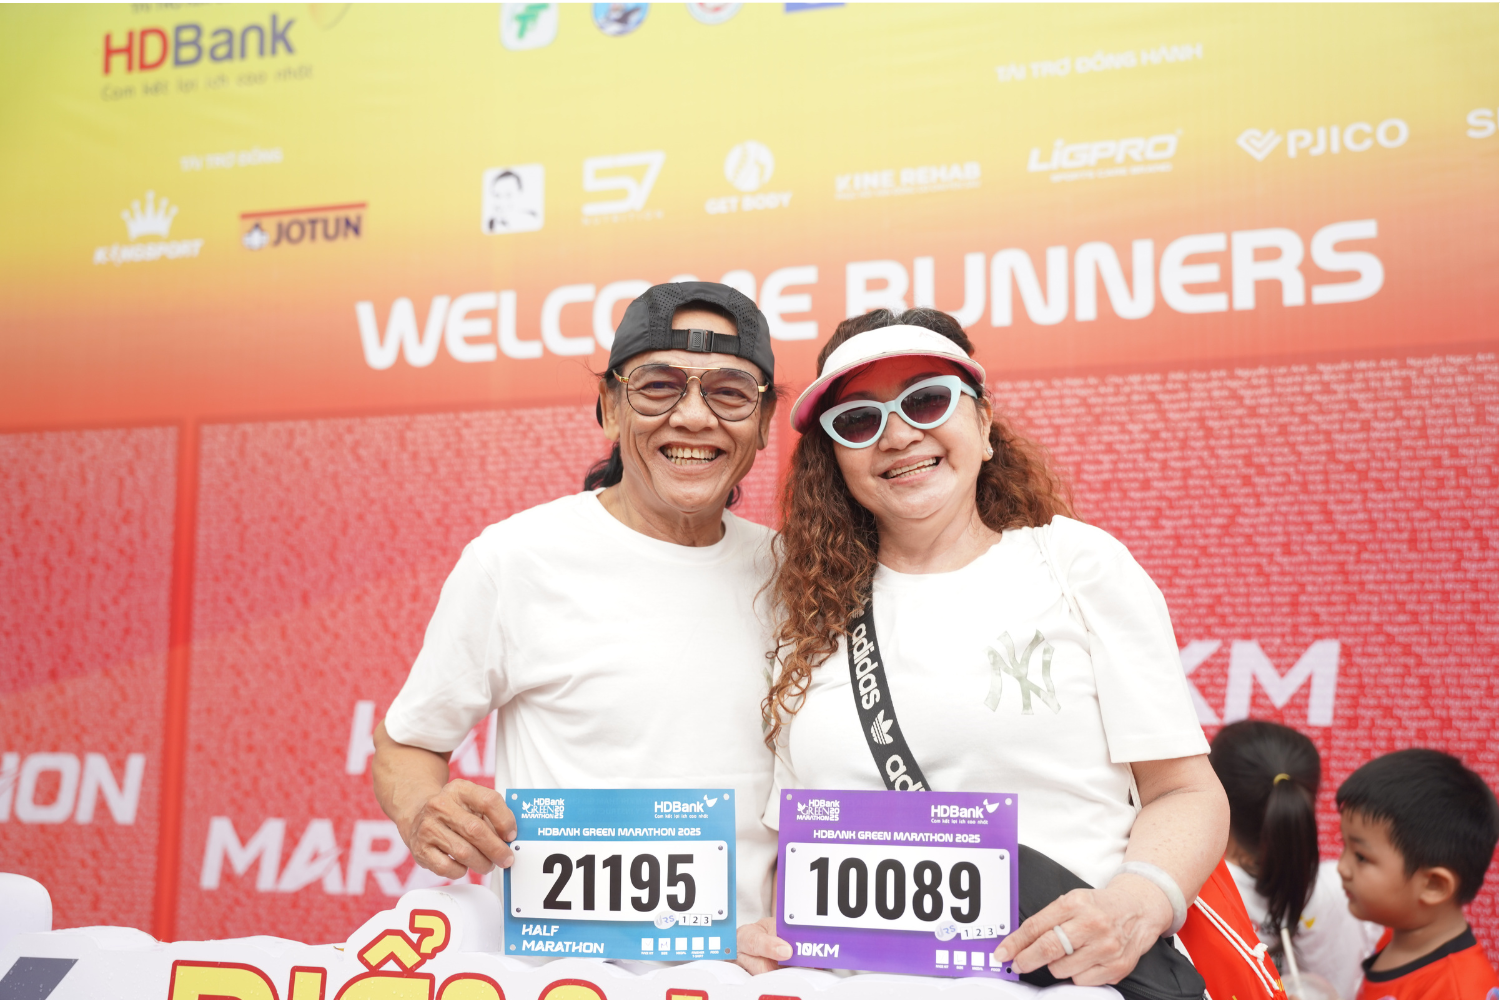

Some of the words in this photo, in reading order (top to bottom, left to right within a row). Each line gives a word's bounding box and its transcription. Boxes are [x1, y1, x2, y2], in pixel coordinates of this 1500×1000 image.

[102, 12, 297, 77] HDBank
[1465, 107, 1498, 139] S
[1287, 118, 1410, 159] PJICO
[900, 161, 982, 187] REHAB
[704, 197, 740, 216] GET
[742, 191, 794, 212] BODY
[272, 215, 364, 248] JOTUN
[844, 218, 1385, 329] RUNNERS
[852, 622, 881, 710] adidas
[533, 798, 565, 806] HDBank
[654, 801, 704, 813] HDBank
[808, 799, 840, 808] HDBank
[931, 805, 984, 819] HDBank
[538, 827, 581, 836] HDBANK
[582, 828, 616, 837] GREEN
[617, 828, 676, 837] MARATHON
[677, 828, 701, 836] 2025
[814, 829, 856, 840] HDBANK
[857, 831, 891, 841] GREEN
[893, 832, 953, 843] MARATHON
[955, 833, 981, 844] 2025
[542, 853, 697, 913] 21195
[809, 856, 982, 924] 10089
[521, 924, 560, 937] HALF
[521, 940, 605, 954] MARATHON
[795, 942, 840, 958] 10KM
